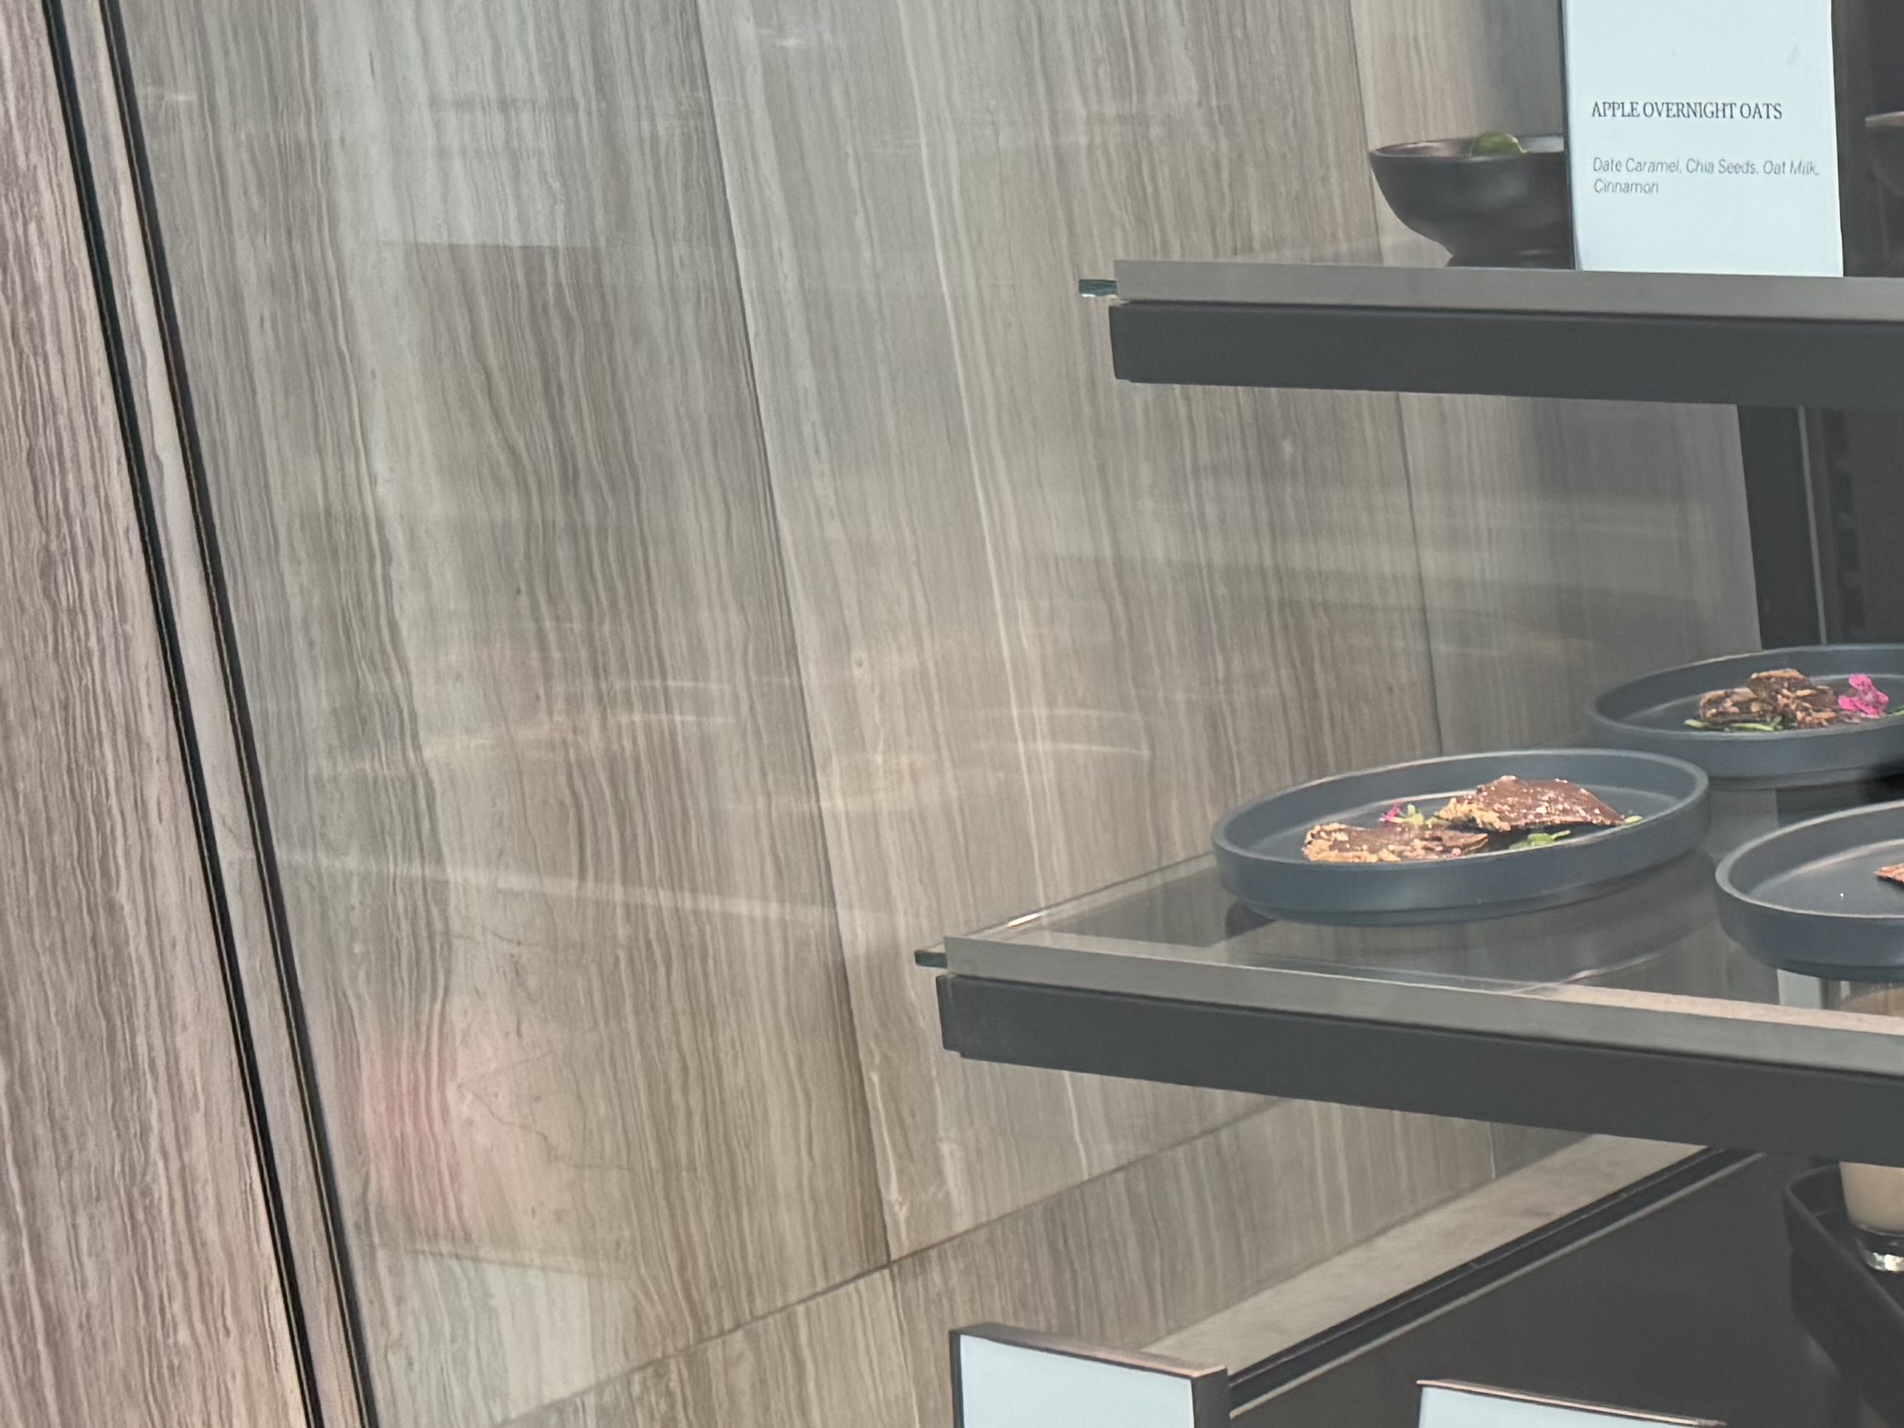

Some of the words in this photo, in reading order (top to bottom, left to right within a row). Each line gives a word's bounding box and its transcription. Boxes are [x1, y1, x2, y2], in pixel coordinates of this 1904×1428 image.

[1592, 101, 1639, 118] APPLE
[1643, 102, 1736, 119] OVERNIGHT
[1740, 103, 1782, 120] OATS
[1594, 157, 1621, 173] Date
[1686, 158, 1714, 174] Chia
[1763, 160, 1785, 175] Oat
[1594, 178, 1658, 194] Cinnamon
